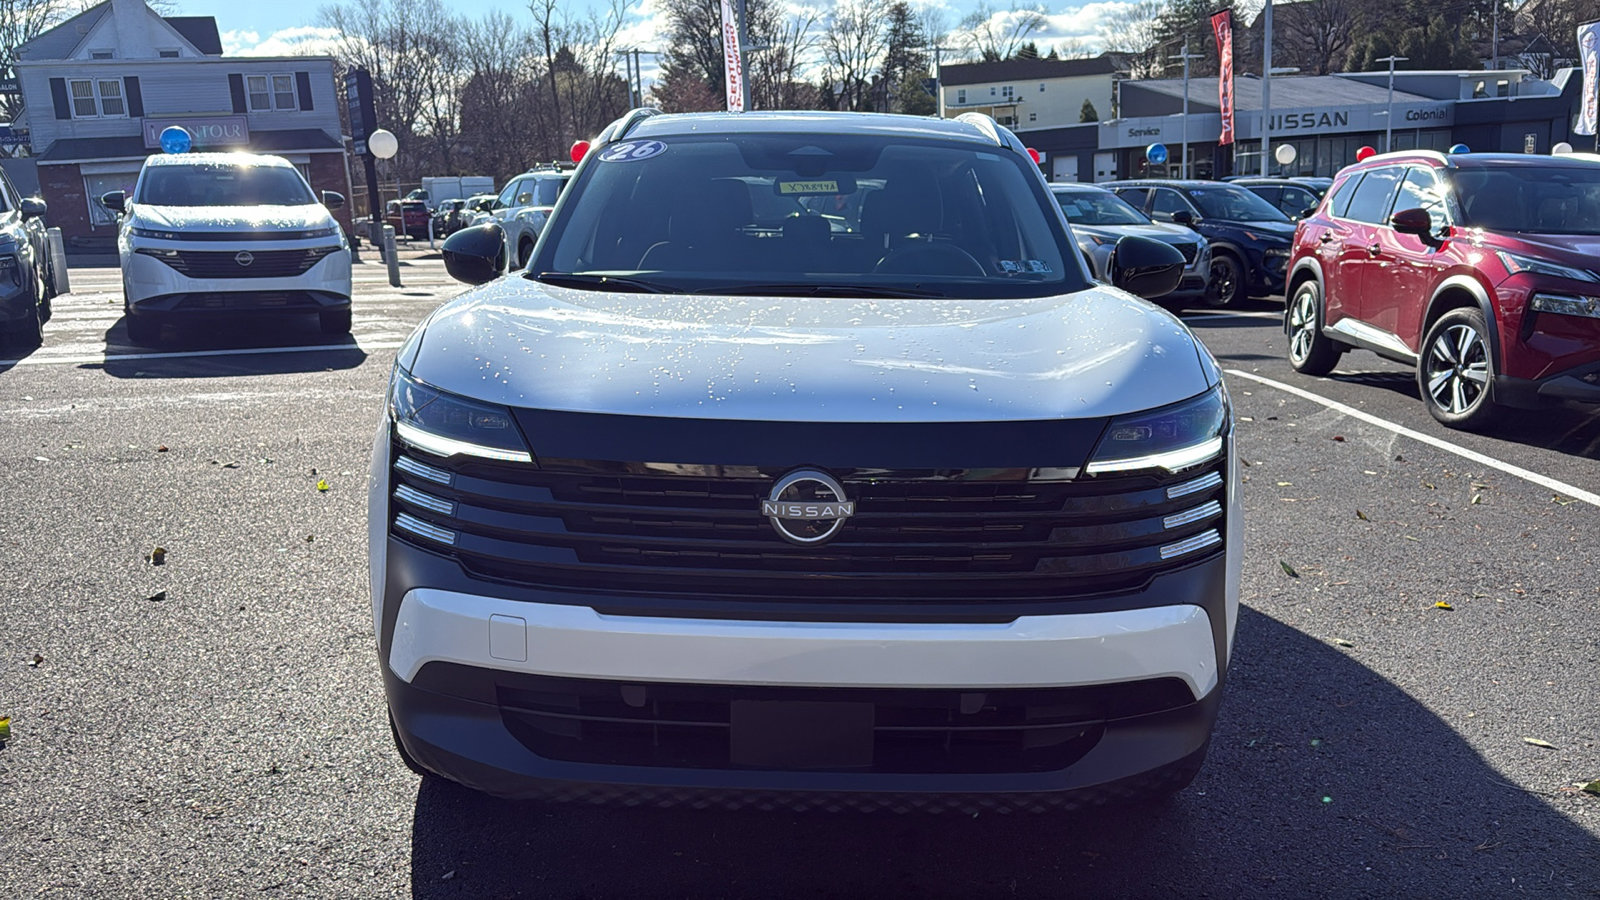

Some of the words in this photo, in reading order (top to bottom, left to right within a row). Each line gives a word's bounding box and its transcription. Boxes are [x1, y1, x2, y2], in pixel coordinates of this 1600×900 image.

[1405, 108, 1449, 121] Colonial
[1127, 126, 1161, 137] Service
[763, 503, 853, 517] NISSAN
